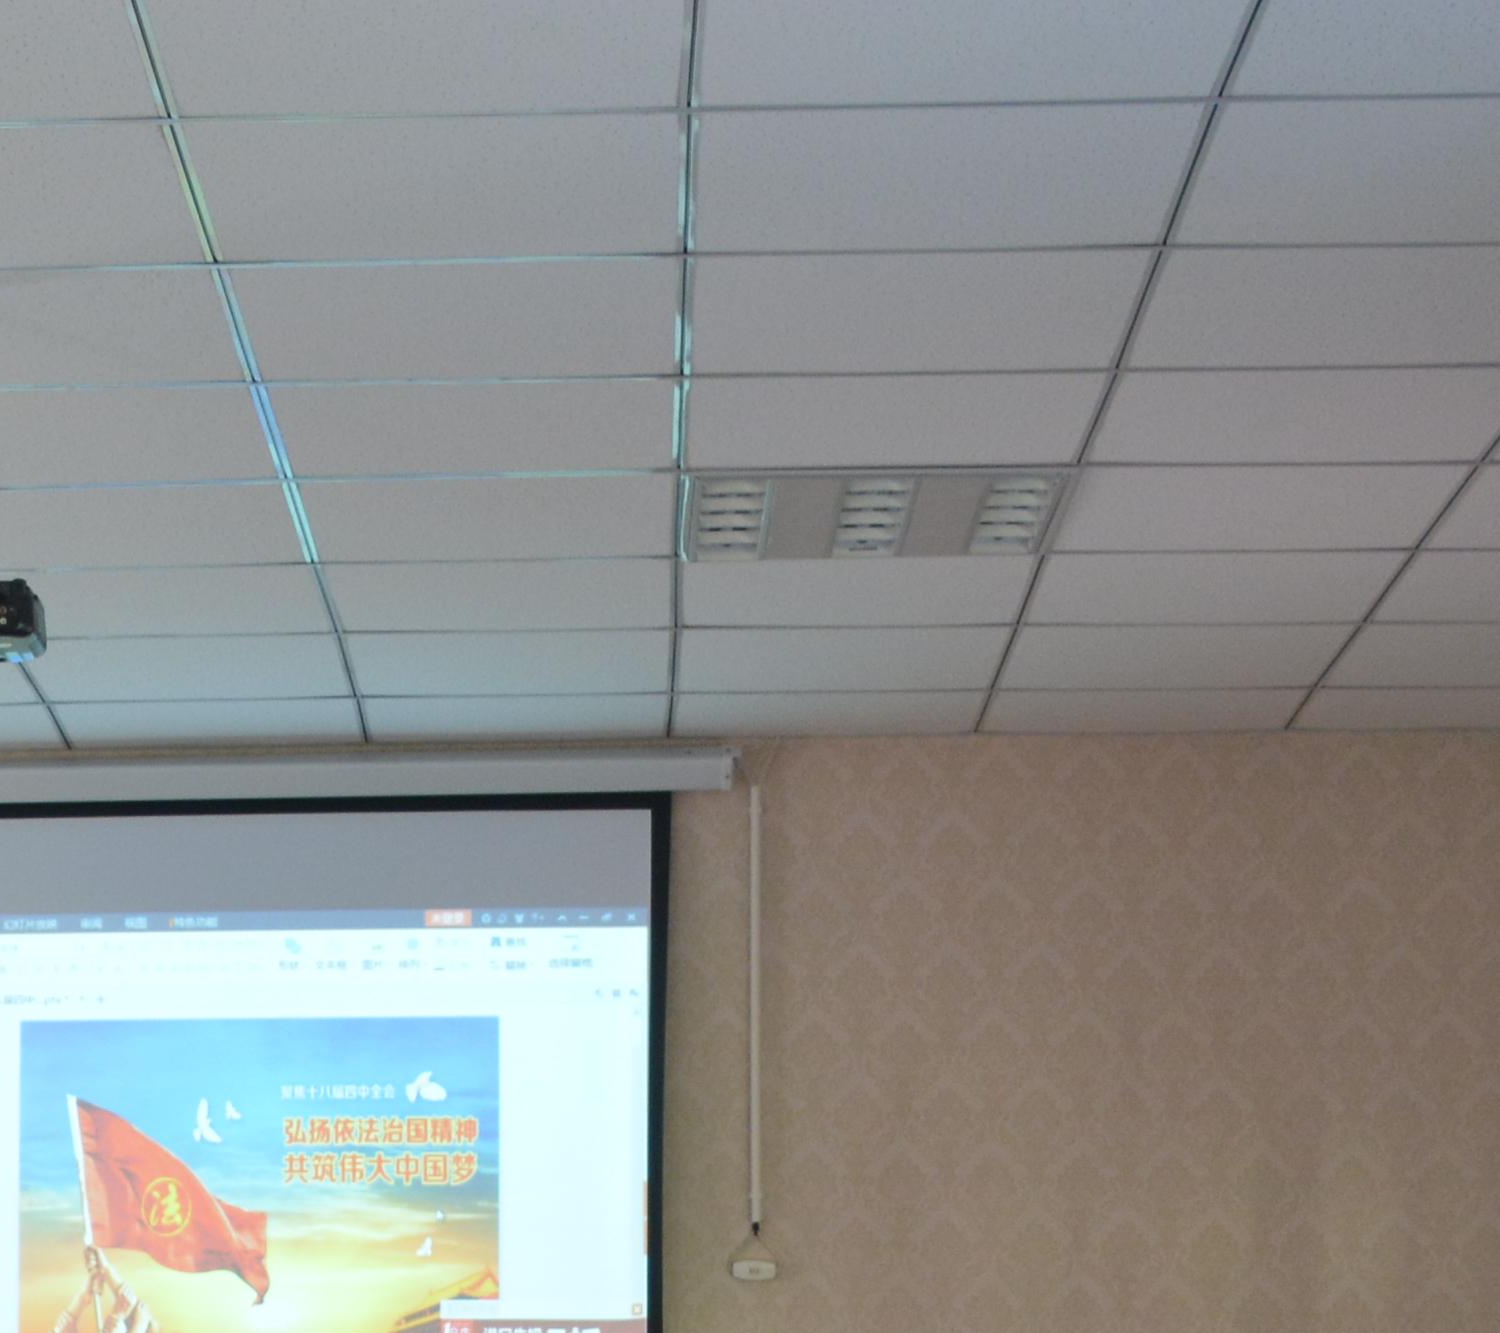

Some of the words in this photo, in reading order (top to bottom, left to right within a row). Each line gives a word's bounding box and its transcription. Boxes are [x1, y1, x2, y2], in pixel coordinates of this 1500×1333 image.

[283, 1116, 479, 1145] 弘扬依法治国精神
[283, 1153, 479, 1184] 共筑伟大中国梦
[149, 1182, 184, 1226] 法
